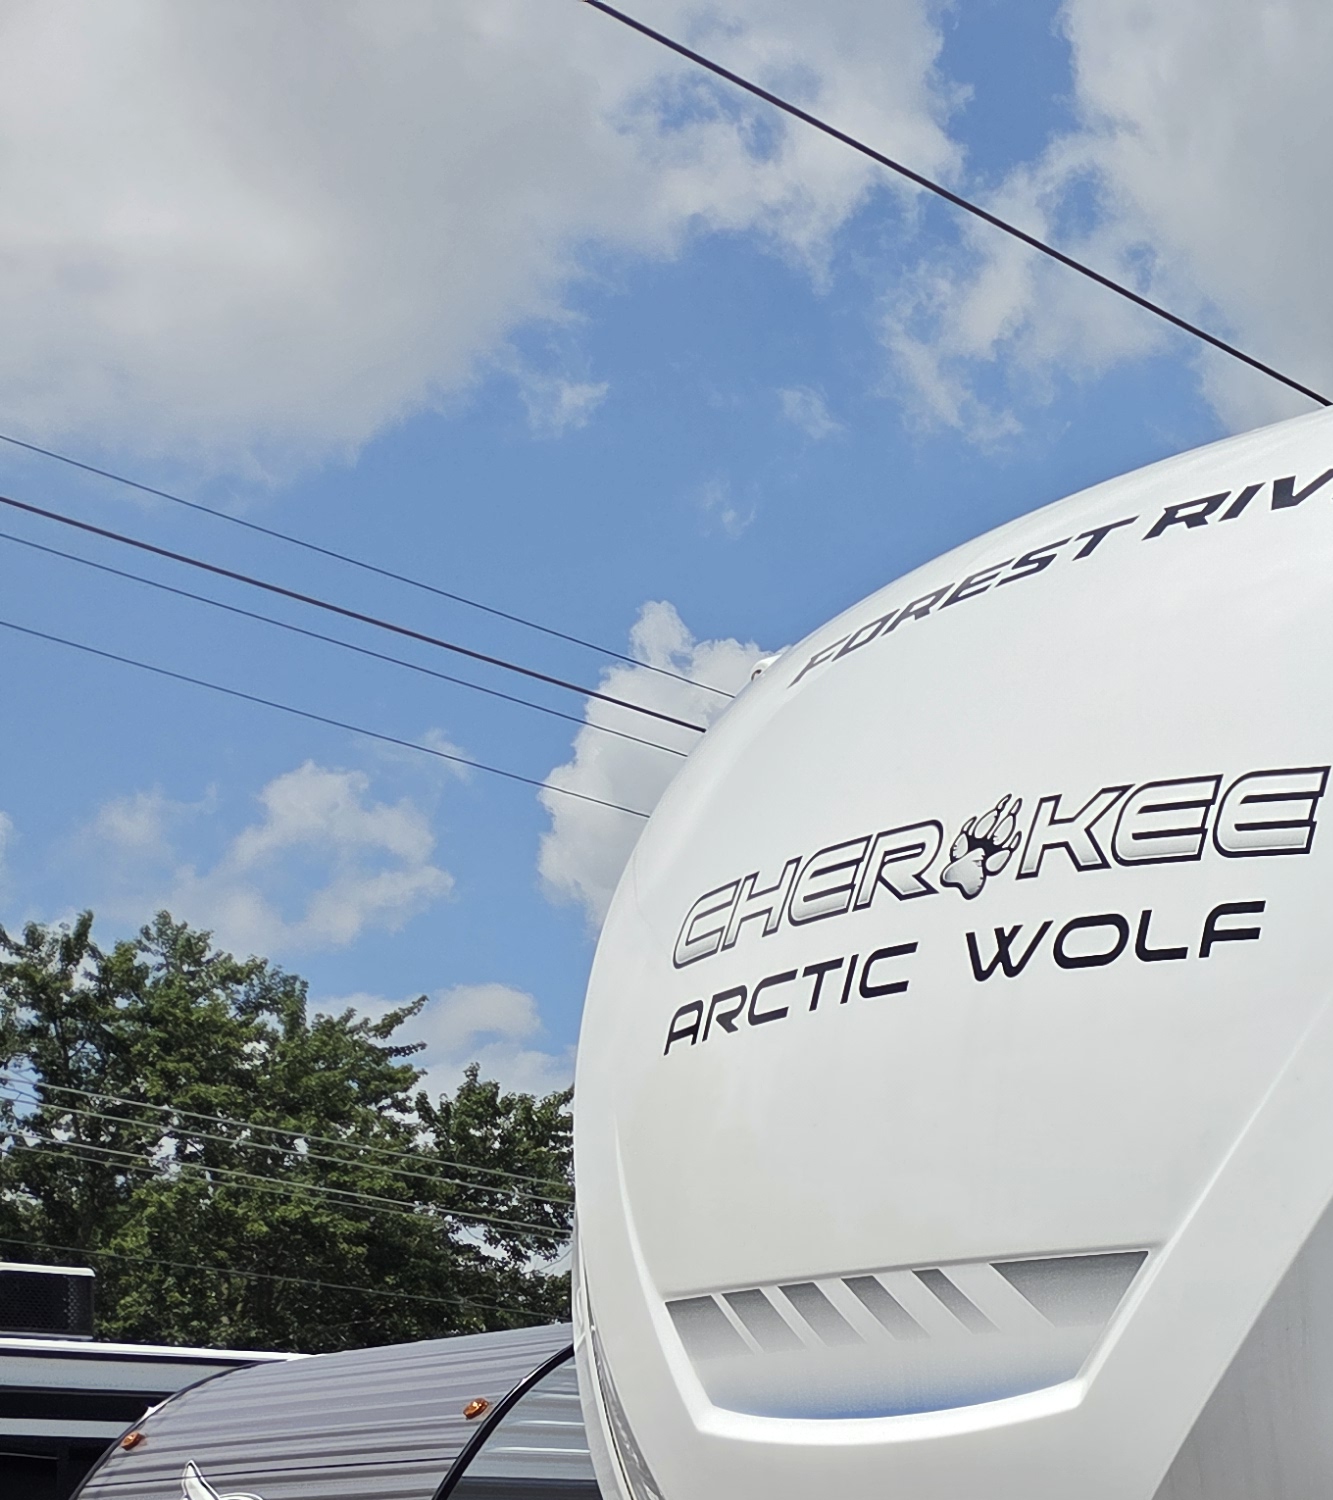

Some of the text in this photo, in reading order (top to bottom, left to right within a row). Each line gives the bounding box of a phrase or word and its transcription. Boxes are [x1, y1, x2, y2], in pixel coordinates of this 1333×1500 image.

[787, 515, 1140, 690] FOREST
[663, 900, 1267, 1056] ARCTIC WOLF
